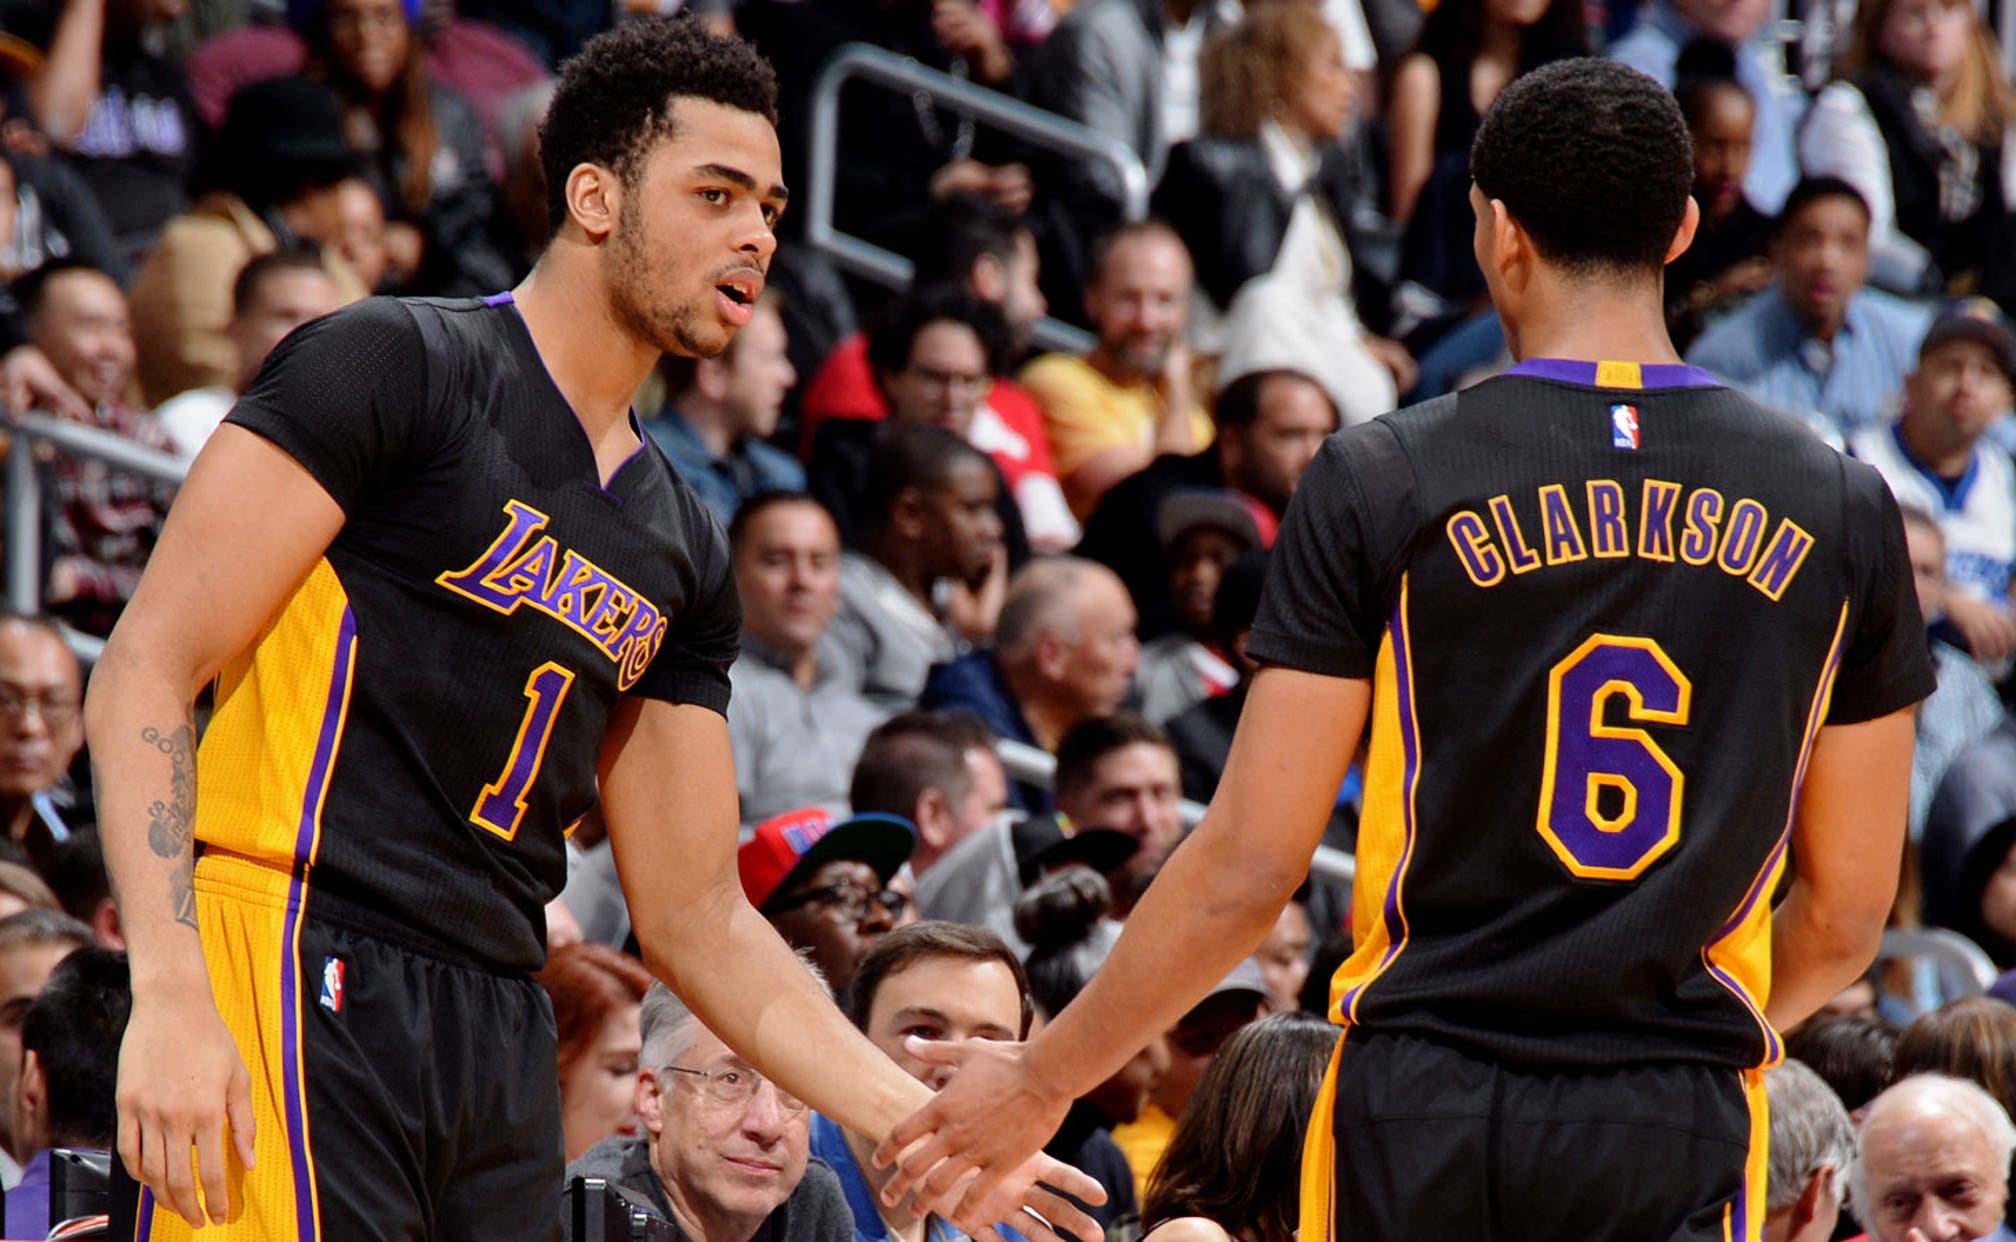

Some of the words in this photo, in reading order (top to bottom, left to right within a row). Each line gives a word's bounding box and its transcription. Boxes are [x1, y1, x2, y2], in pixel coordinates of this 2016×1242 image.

[435, 499, 667, 692] LAKERS
[1446, 479, 1815, 602] CLARKSON
[468, 660, 576, 842] 1
[1536, 633, 1692, 880] 6
